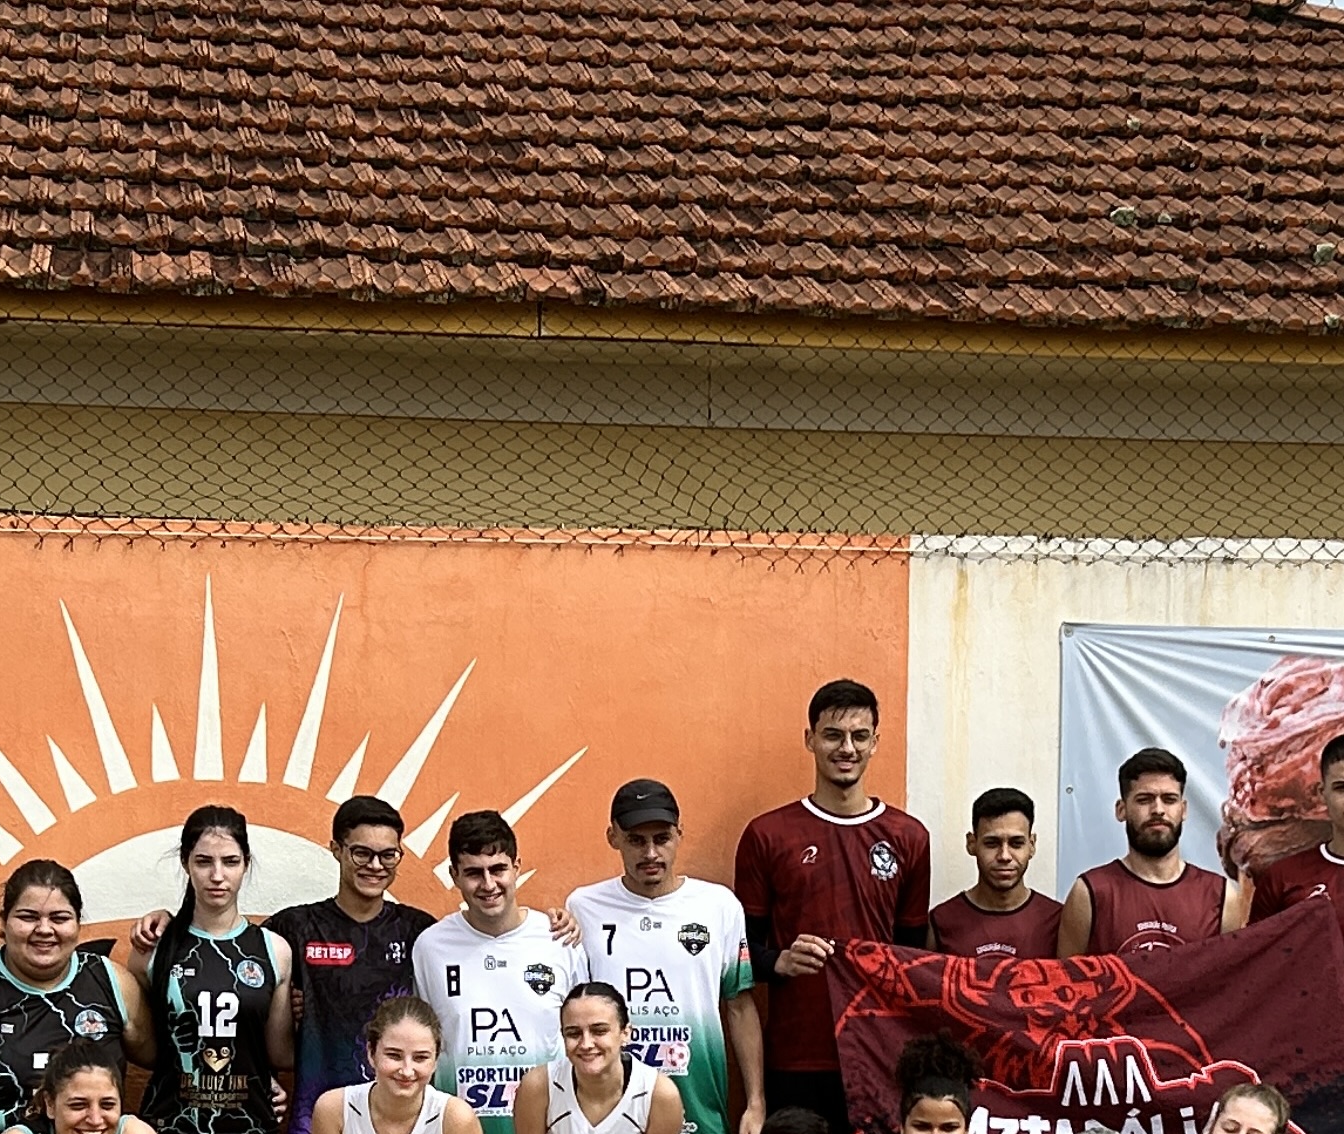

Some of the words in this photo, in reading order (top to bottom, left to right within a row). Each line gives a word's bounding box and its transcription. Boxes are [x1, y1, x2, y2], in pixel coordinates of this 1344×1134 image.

[602, 923, 617, 956] 7
[446, 964, 461, 997] 8
[626, 967, 676, 1002] PA
[197, 990, 239, 1038] 12
[470, 1007, 523, 1043] PA
[628, 1005, 650, 1016] LIS
[653, 1005, 681, 1018] AÇO
[630, 1026, 690, 1043] ORTLINS
[467, 1046, 495, 1056] PLIS
[500, 1046, 528, 1058] AÇO
[458, 1065, 537, 1084] SPORTLIN
[465, 1083, 509, 1109] SL
